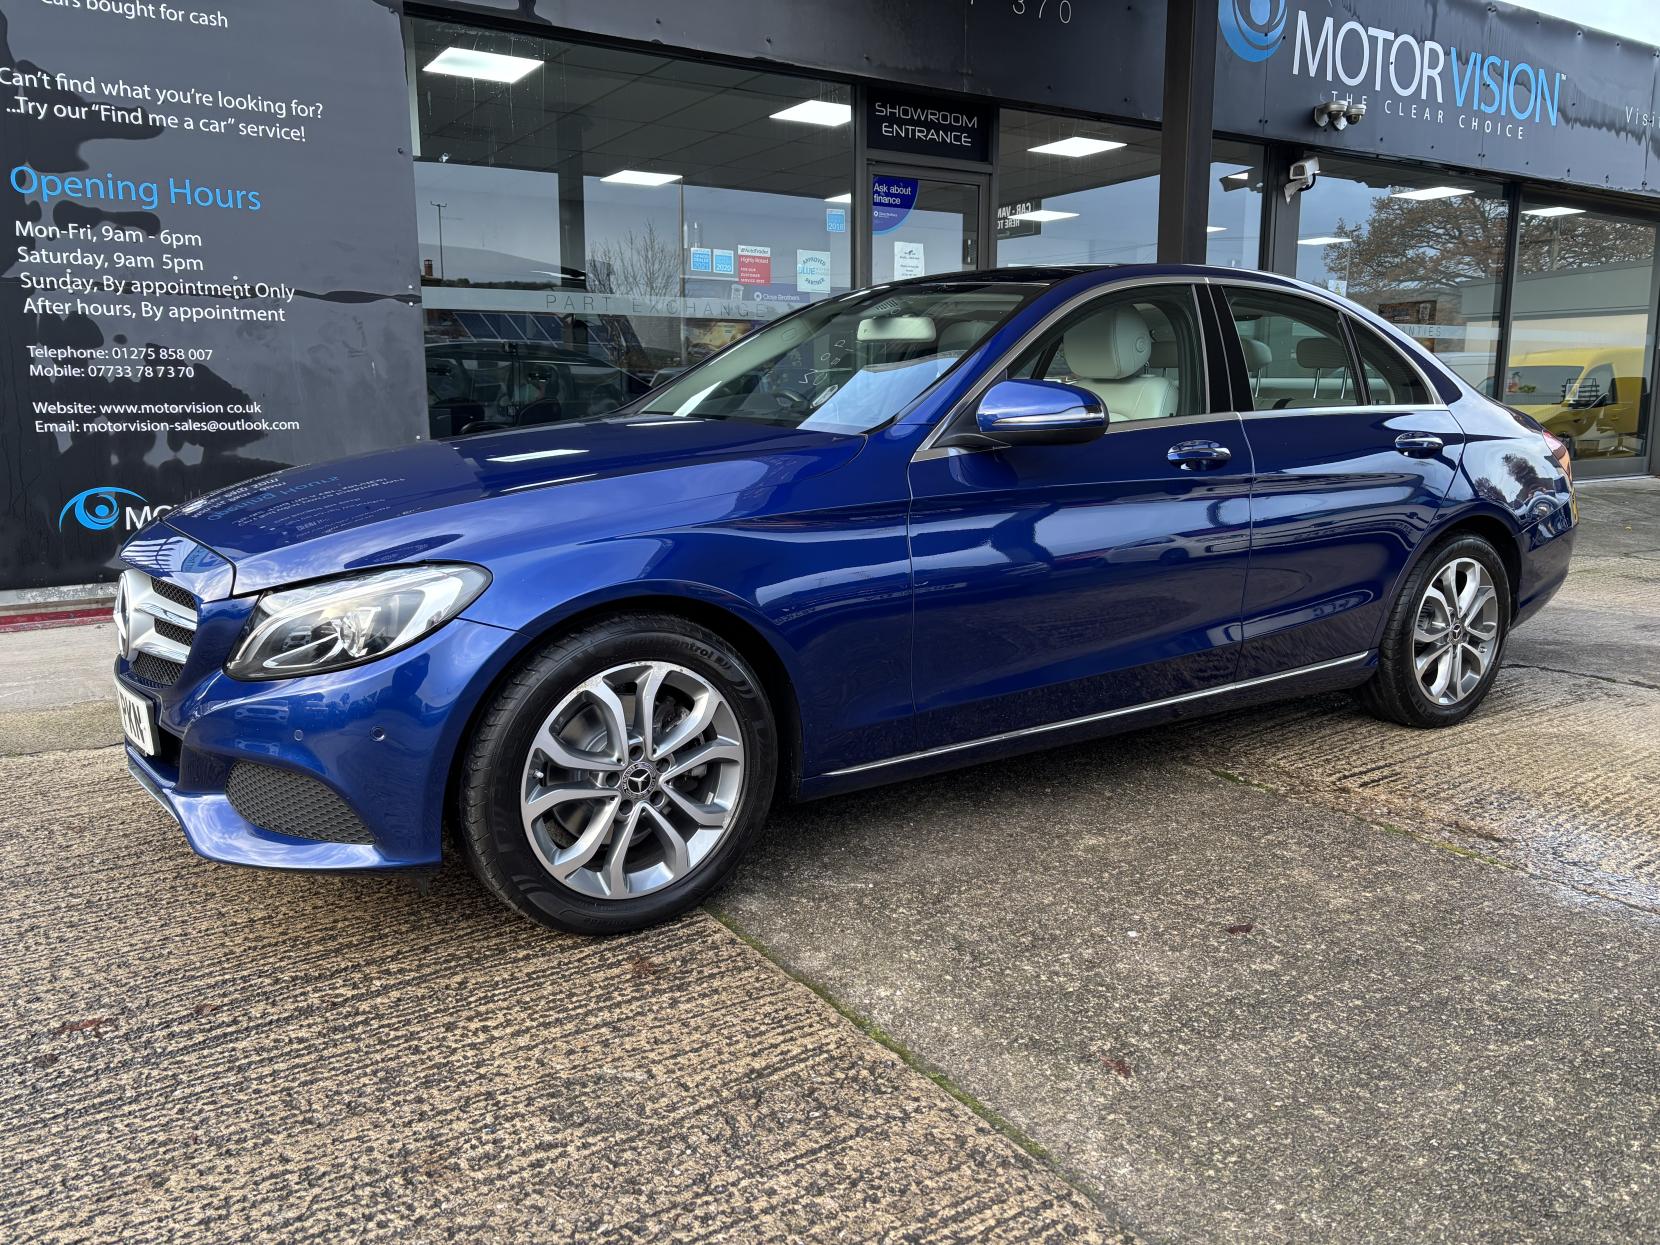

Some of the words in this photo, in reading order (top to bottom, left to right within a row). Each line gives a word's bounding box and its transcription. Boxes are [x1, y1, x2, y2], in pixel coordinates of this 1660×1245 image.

[86, 0, 157, 20] bought
[159, 4, 185, 22] for
[189, 11, 228, 28] cash
[0, 67, 51, 90] Can't
[55, 73, 96, 95] find
[101, 80, 151, 100] what
[155, 88, 213, 105] you're
[218, 91, 286, 118] looking
[291, 100, 323, 119] for?
[53, 104, 89, 120] our
[92, 104, 142, 125] "Find
[149, 113, 179, 129] me
[184, 117, 194, 130] a
[200, 117, 236, 133] car"
[239, 123, 305, 142] service!
[875, 102, 978, 129] SHOWROOM
[1384, 100, 1444, 124] CLEAR
[1459, 114, 1523, 139] CHOICE
[1625, 104, 1660, 128] Visi
[882, 122, 972, 147] ENTRANCE
[10, 165, 158, 210] Opening
[169, 177, 261, 210] Hours
[873, 183, 889, 193] Ask
[889, 185, 912, 195] about
[873, 194, 901, 205] finance
[15, 221, 97, 242] Mon-Fri,
[102, 225, 145, 243] 9am
[160, 230, 202, 248] 6pm
[17, 247, 109, 270] Saturday,
[114, 252, 154, 268] 9am
[162, 254, 204, 273] 5pm
[20, 272, 97, 292] Sunday,
[103, 275, 125, 295] By
[131, 279, 251, 298] appointment
[255, 283, 296, 303] Only
[23, 298, 72, 315] After
[77, 299, 137, 318] hours,
[141, 302, 163, 321] By
[169, 305, 286, 322] appointment
[546, 294, 613, 312] PART
[632, 299, 767, 318] EXCHANGE
[26, 345, 109, 360] Telephone:
[112, 347, 155, 360] 01275
[159, 348, 185, 360] 858
[188, 349, 213, 361] 007
[29, 364, 85, 377] Mobile:
[88, 366, 132, 378] 07733
[32, 401, 97, 414] Website:
[35, 420, 81, 433] Email:
[83, 419, 300, 433] motorvision-sales@outlook.com
